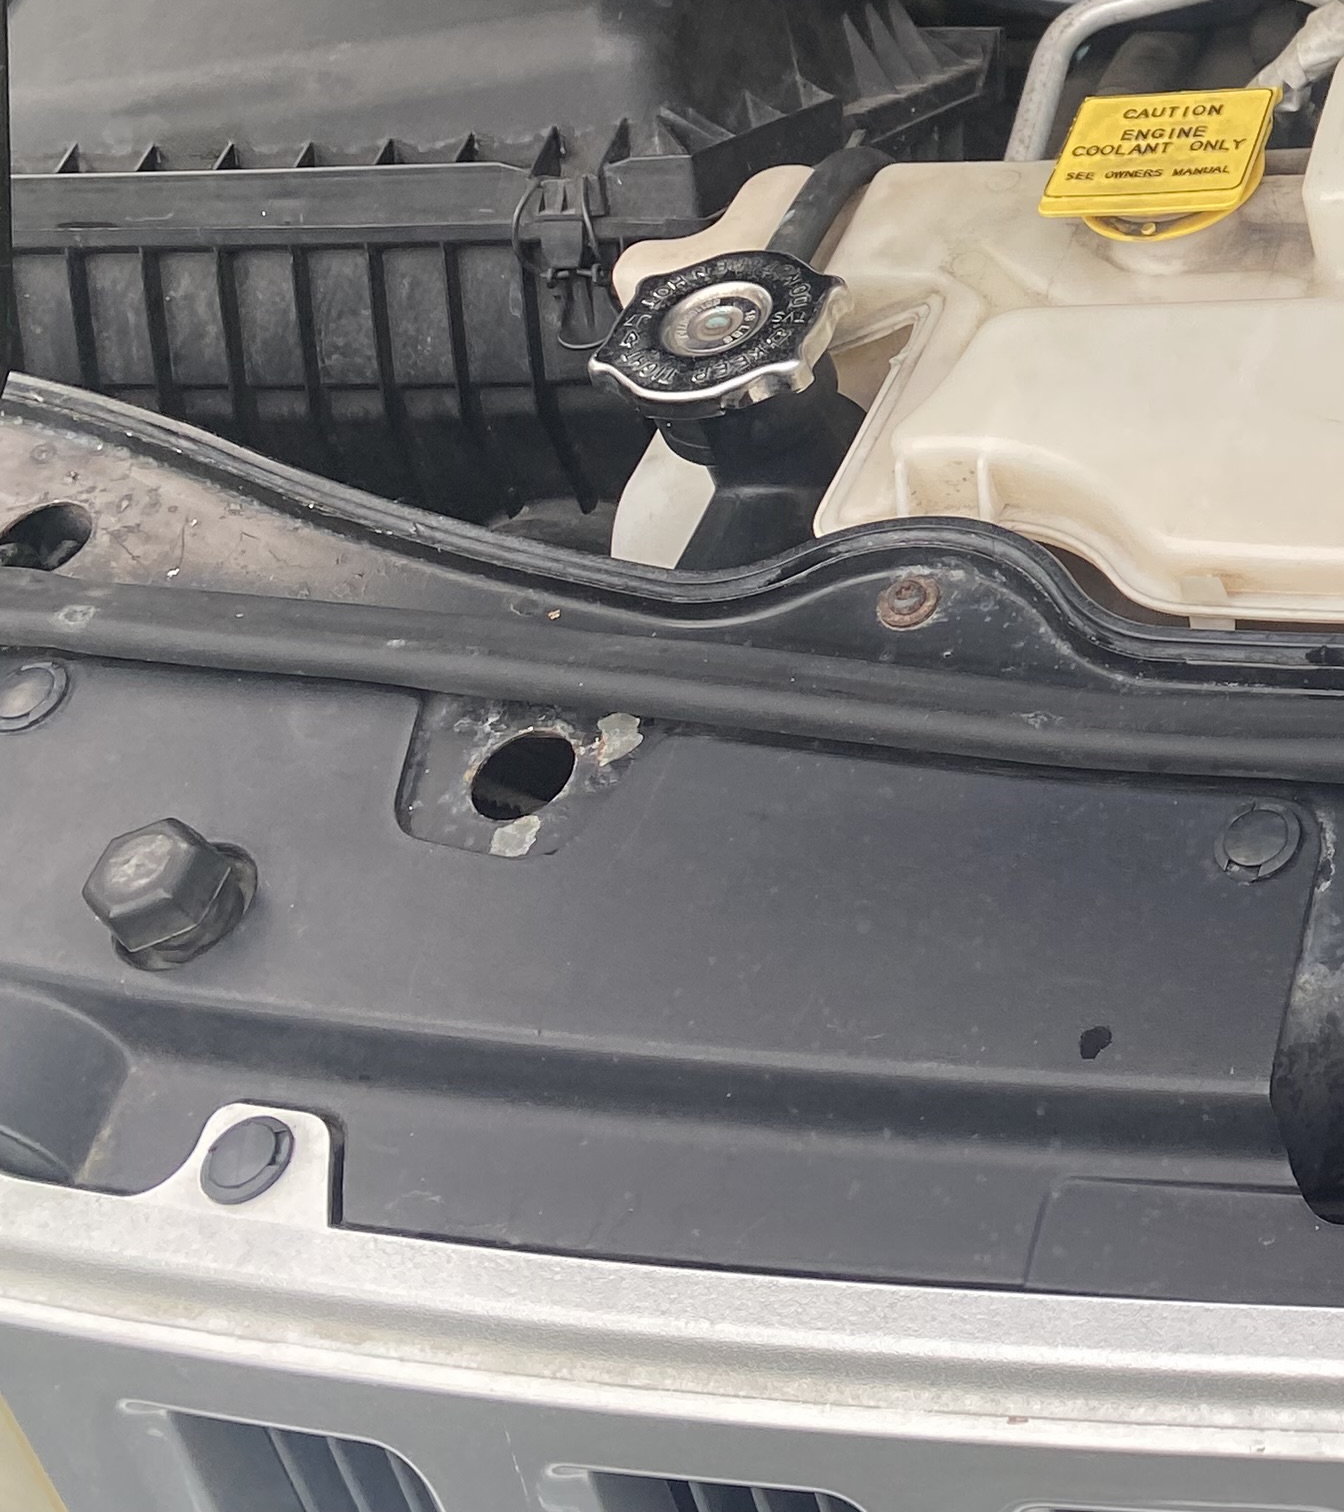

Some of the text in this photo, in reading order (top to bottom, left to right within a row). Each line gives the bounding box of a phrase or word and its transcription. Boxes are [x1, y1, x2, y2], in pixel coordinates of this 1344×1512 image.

[1122, 103, 1225, 120] CAUTION
[1119, 125, 1209, 142] ENGINE
[1071, 138, 1247, 157] COOLANT ONLY
[1064, 164, 1231, 181] SEE OWNERS MANUAL
